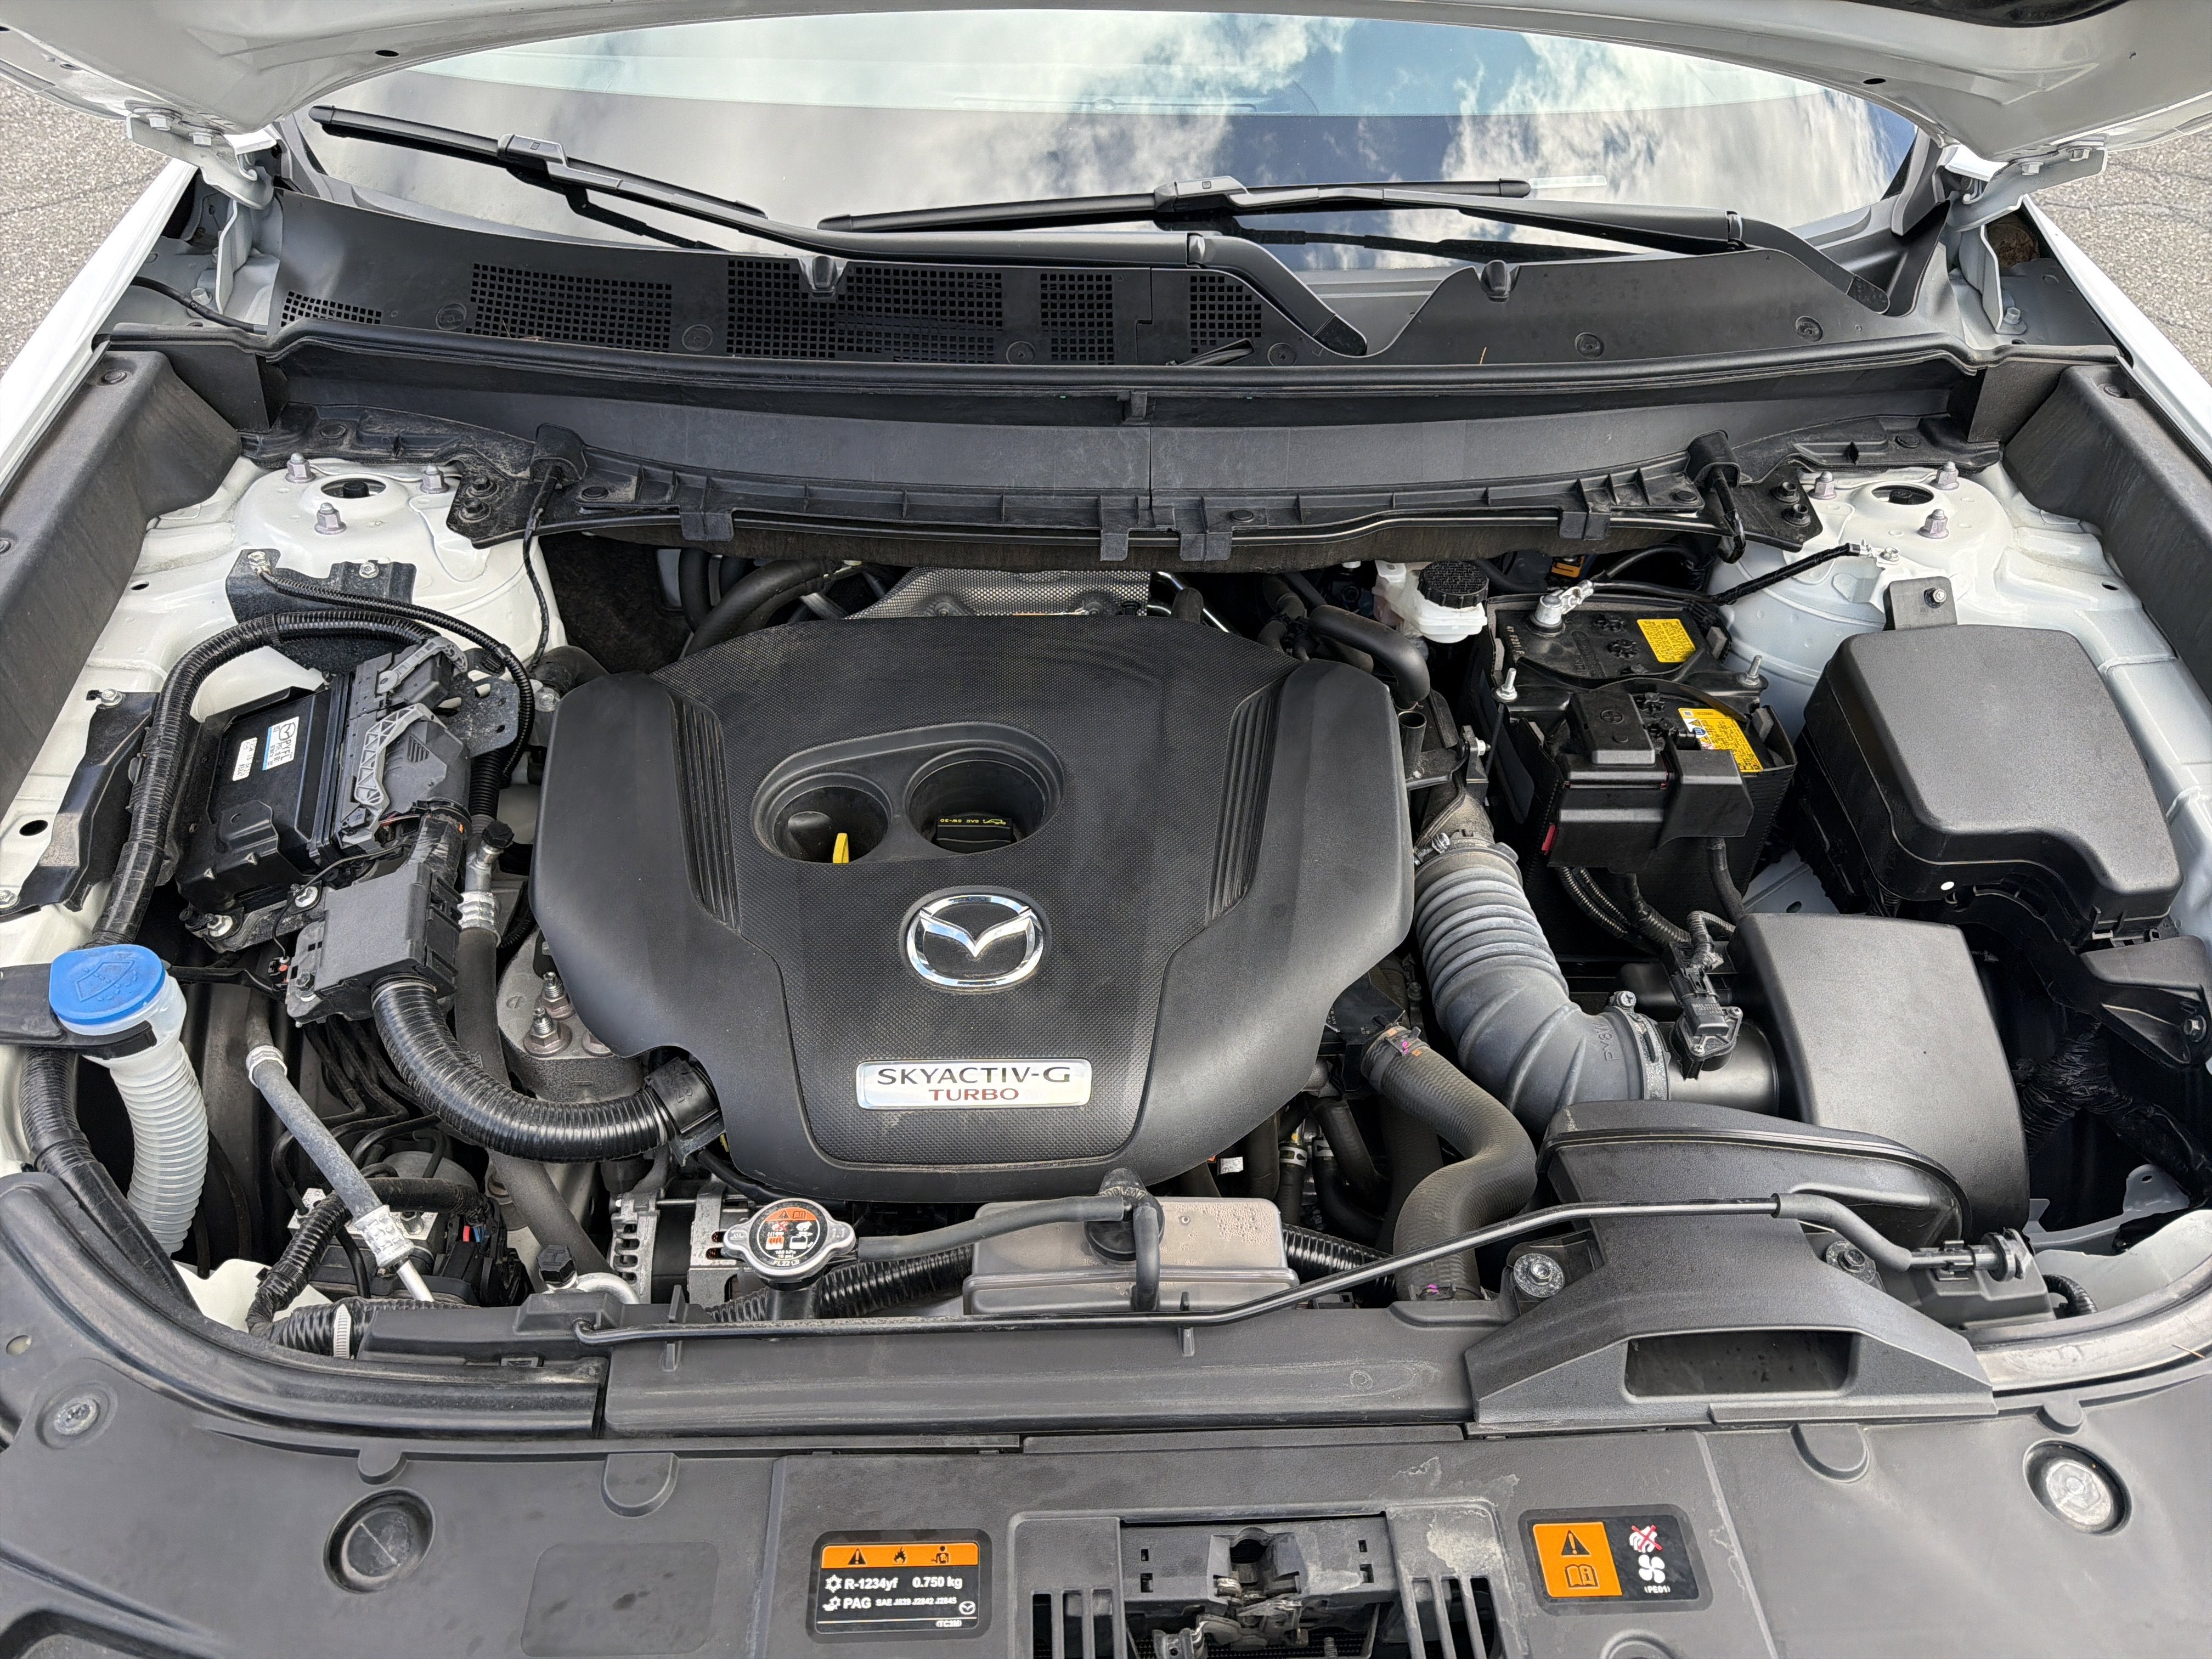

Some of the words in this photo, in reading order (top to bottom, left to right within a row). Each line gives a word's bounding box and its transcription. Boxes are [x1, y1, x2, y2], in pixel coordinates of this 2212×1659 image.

[877, 1066, 1071, 1086] SKYACTIV-G
[928, 1088, 1019, 1101] TURBO
[831, 1228, 845, 1238] 1.1
[844, 1577, 899, 1592] R-1234yf
[912, 1576, 945, 1588] 0.750
[946, 1576, 963, 1589] kg
[843, 1596, 872, 1610] PAG
[875, 1598, 893, 1606] SAE
